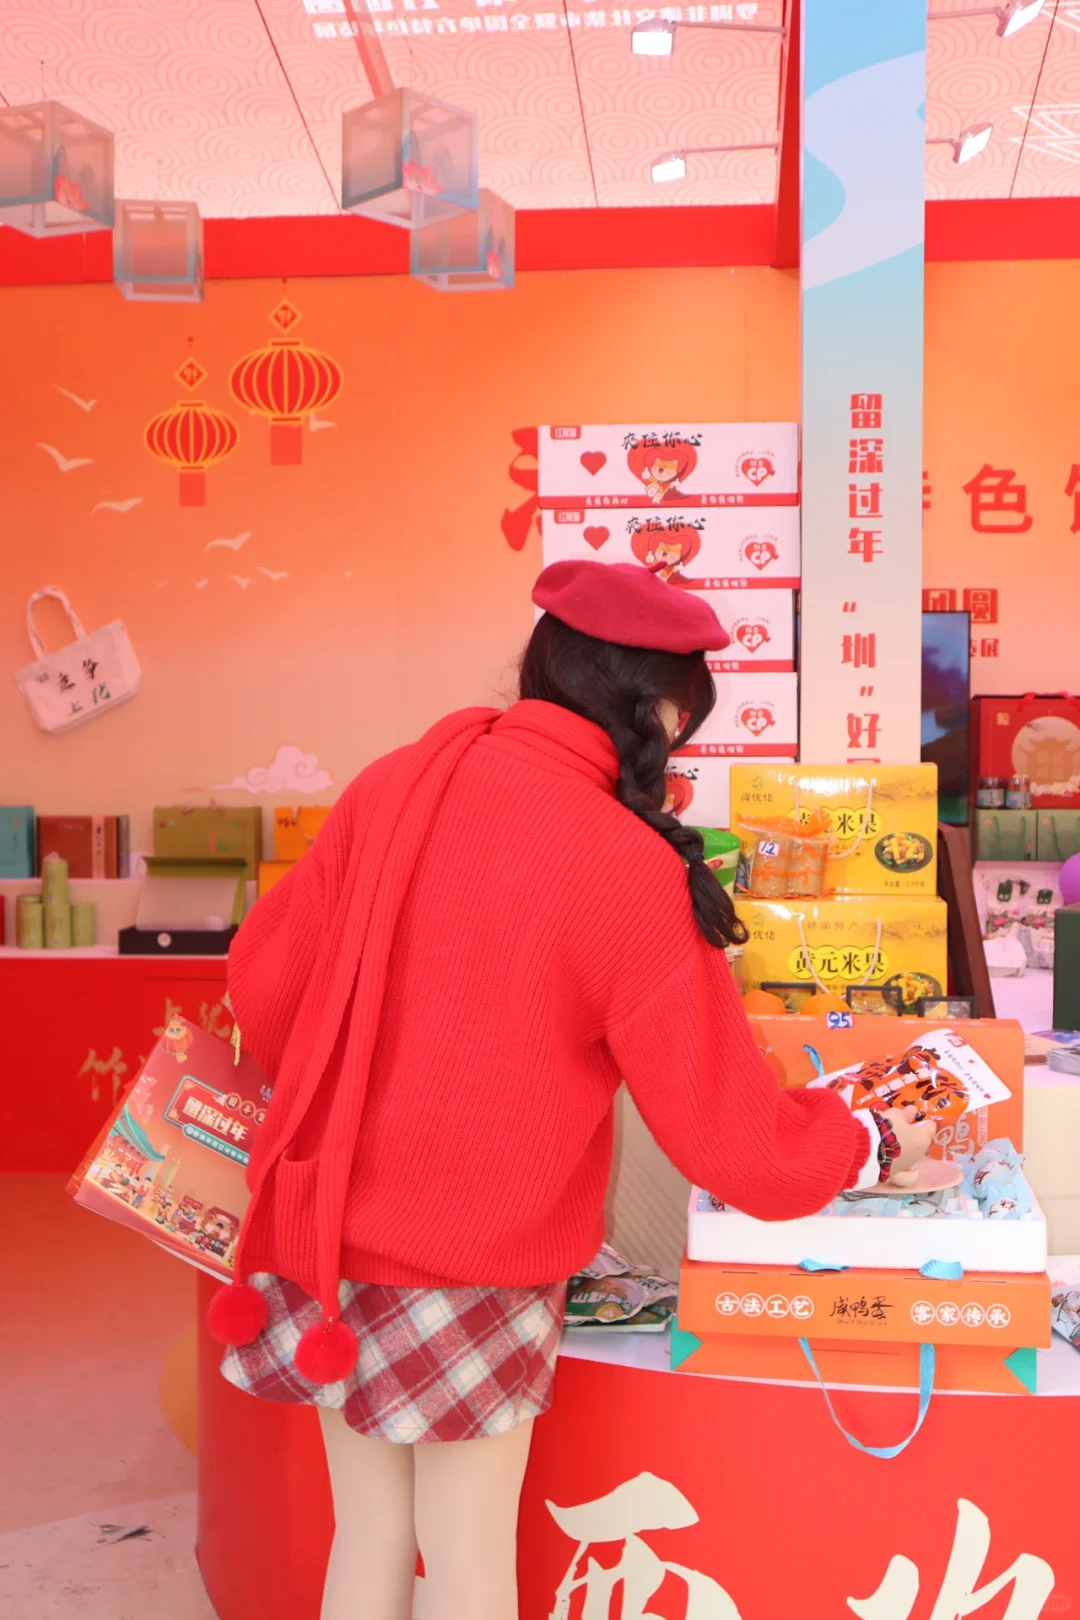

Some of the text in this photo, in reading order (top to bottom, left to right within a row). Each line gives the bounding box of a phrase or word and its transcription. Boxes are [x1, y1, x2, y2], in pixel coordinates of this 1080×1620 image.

[841, 393, 884, 764] 留深过年 “圳”好
[760, 842, 777, 856] 12
[796, 951, 885, 975] 黄元米果
[828, 1012, 852, 1029] 95
[717, 1293, 813, 1318] 古法工艺
[913, 1302, 1009, 1328] 客家传承
